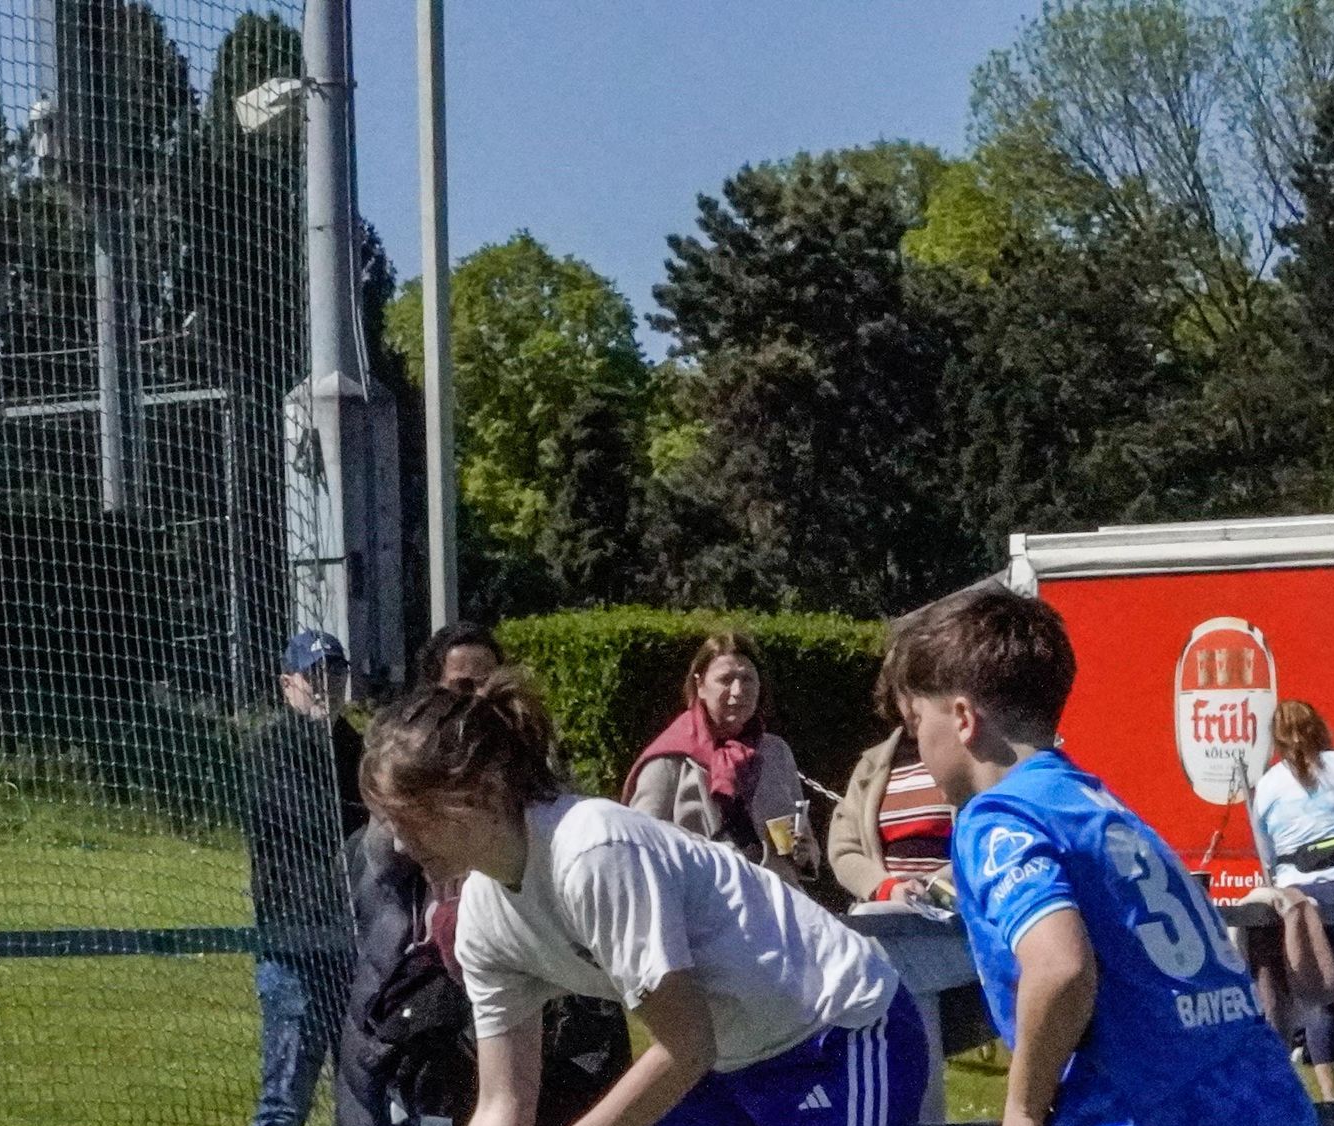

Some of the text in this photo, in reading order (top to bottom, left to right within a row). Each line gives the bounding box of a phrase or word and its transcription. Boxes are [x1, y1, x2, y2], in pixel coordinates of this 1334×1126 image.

[1190, 697, 1258, 748] früh
[1204, 747, 1246, 760] KÖLSCH
[993, 856, 1051, 906] NIEDAX
[1176, 986, 1256, 1028] BAYER
